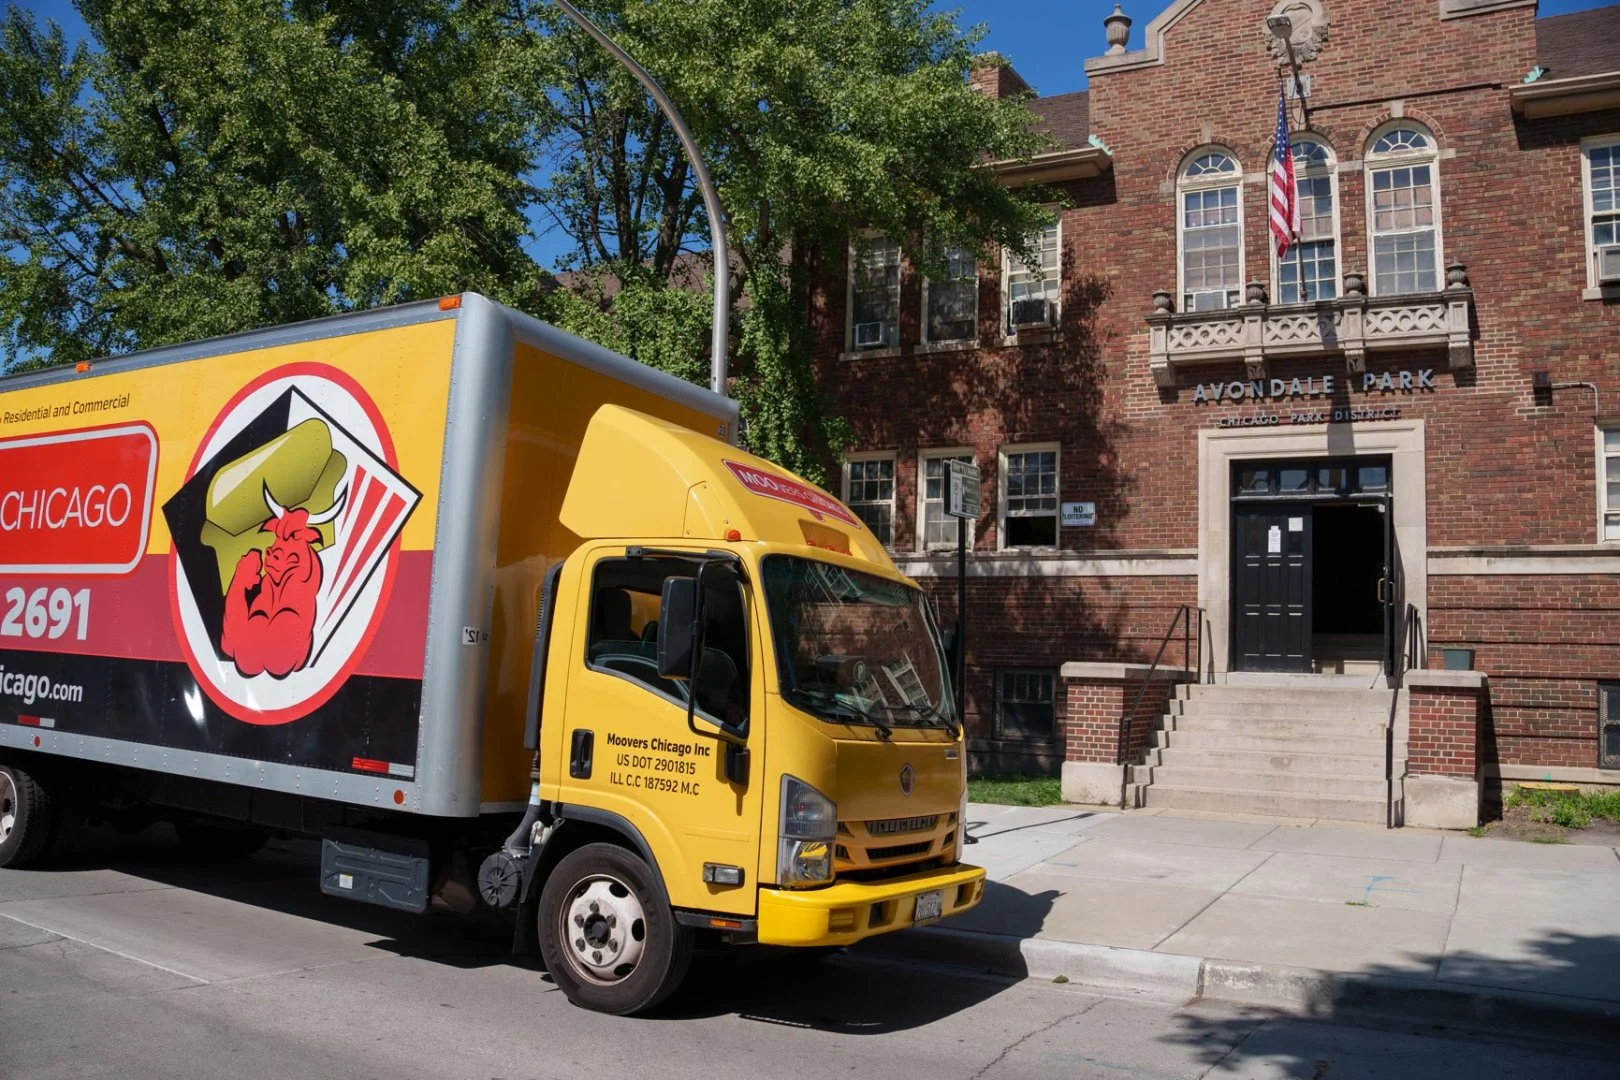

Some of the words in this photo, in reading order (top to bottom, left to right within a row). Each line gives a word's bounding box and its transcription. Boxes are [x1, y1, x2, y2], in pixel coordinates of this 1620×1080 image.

[1193, 376, 1335, 401] AVONDALE
[1363, 368, 1433, 391] PARK
[3, 405, 51, 424] Residential
[53, 402, 70, 417] and
[73, 393, 130, 414] Commercial
[1220, 414, 1278, 427] CHICAGO
[1291, 411, 1324, 422] PARK
[1335, 407, 1398, 420] DISTRICT
[1, 483, 131, 531] CHICAGO
[1073, 505, 1083, 513] NO
[1, 587, 91, 640] 2691
[607, 733, 648, 749] Moovers
[651, 738, 691, 756] Chicago
[694, 743, 710, 756] Inc
[617, 753, 629, 766] US
[632, 755, 653, 769] DOT
[654, 758, 696, 775] 2901815
[610, 772, 623, 785] ILL
[626, 774, 641, 787] C.C
[644, 776, 678, 793] 187592
[681, 781, 700, 796] M.C
